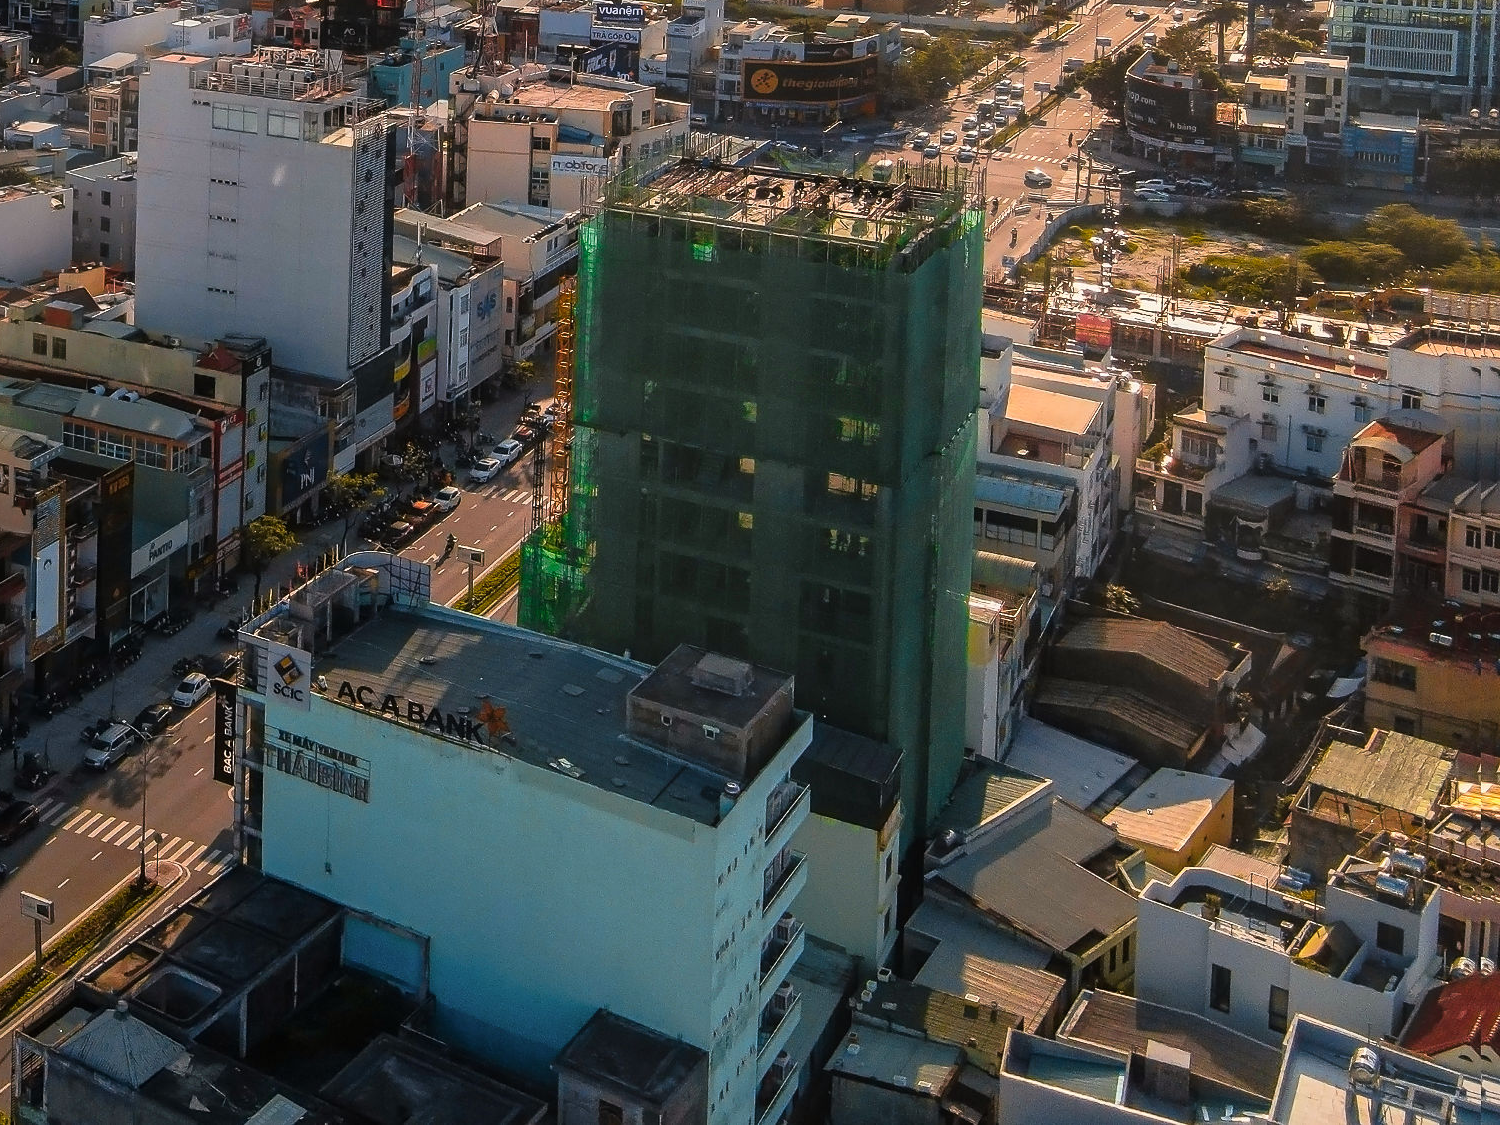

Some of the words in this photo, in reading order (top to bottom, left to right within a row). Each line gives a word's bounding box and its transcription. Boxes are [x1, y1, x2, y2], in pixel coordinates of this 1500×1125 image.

[300, 467, 315, 490] PNJ
[273, 682, 304, 702] SCIC
[224, 704, 234, 737] BANK
[407, 699, 485, 745] BANK
[223, 750, 232, 774] BAC
